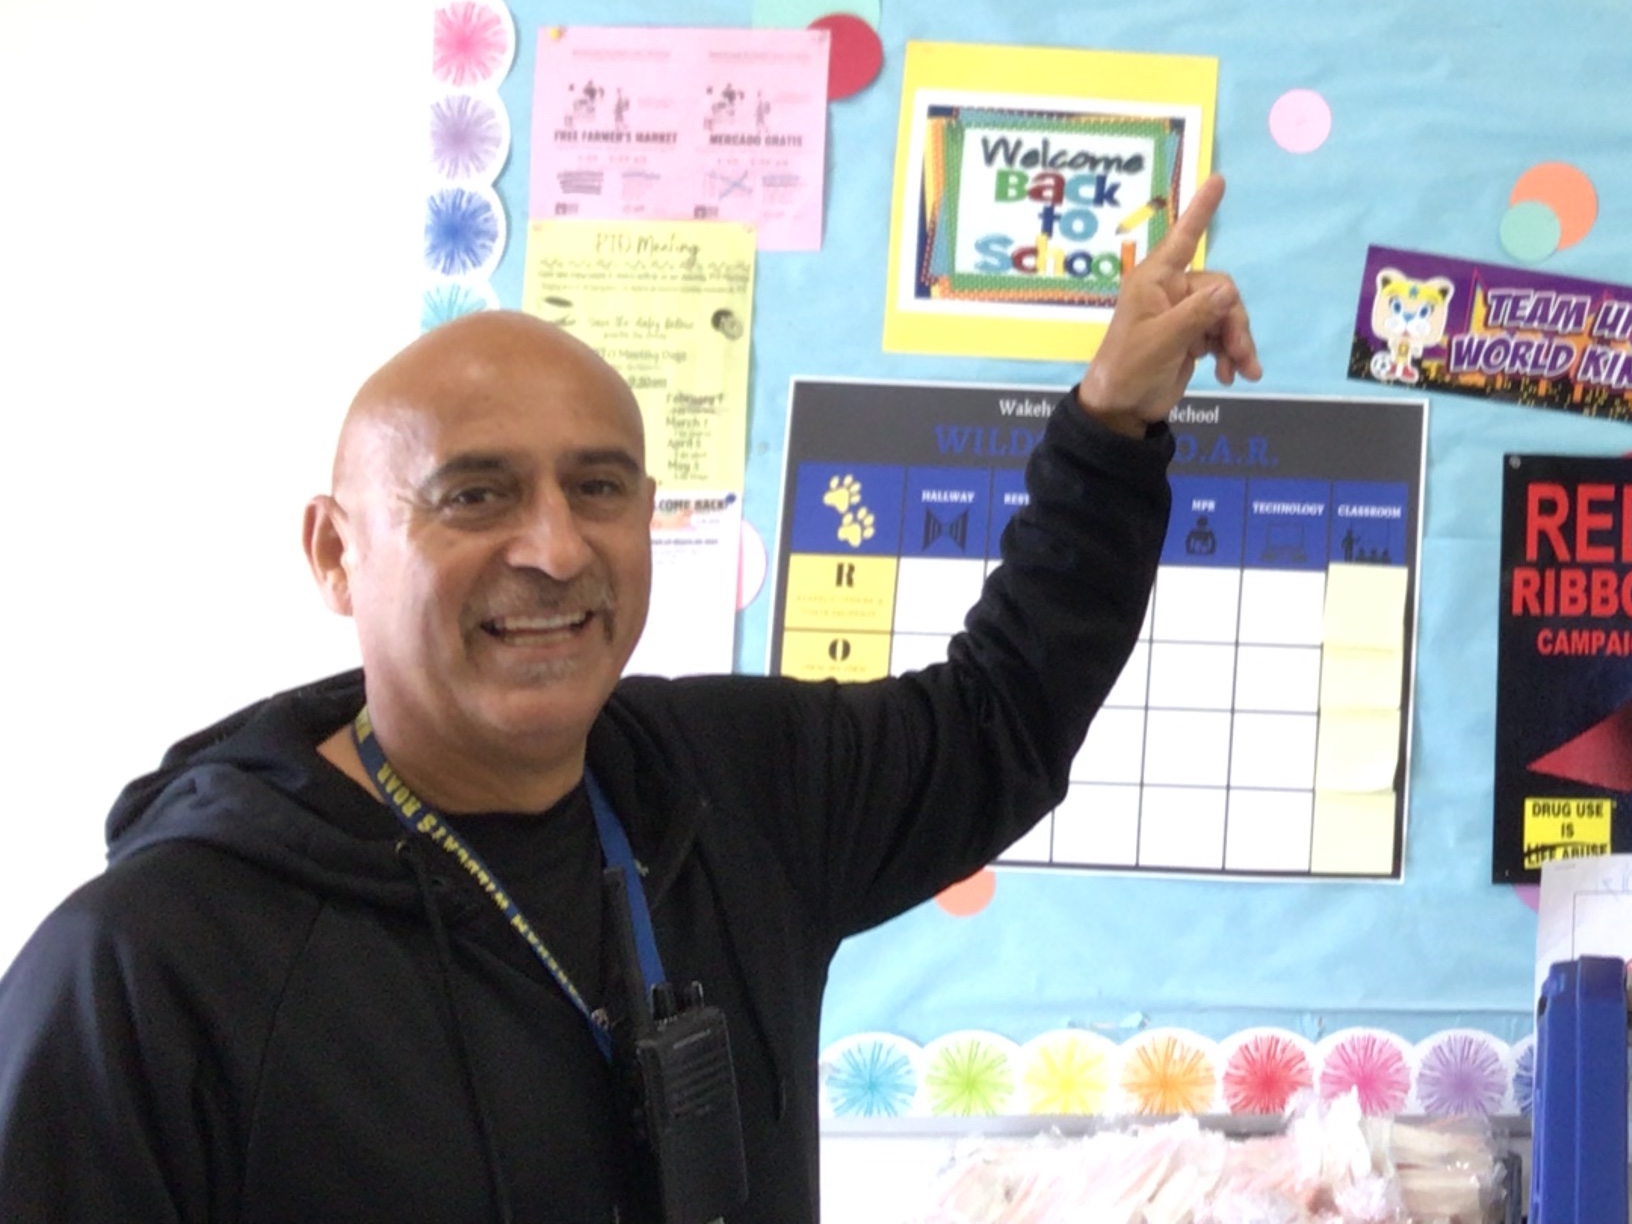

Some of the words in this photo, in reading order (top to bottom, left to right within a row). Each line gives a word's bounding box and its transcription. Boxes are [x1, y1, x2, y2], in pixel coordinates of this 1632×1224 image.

[554, 130, 578, 143] FREE
[581, 130, 631, 144] FARMER'S
[635, 131, 677, 145] MARKET
[709, 133, 761, 146] MERCADO
[981, 134, 1145, 176] Welcome
[1038, 204, 1099, 243] to
[636, 232, 699, 262] Meeting
[973, 232, 1137, 280] School
[1487, 288, 1591, 333] TEAM
[1449, 333, 1576, 377] WORLD
[998, 398, 1055, 418] Wakeh
[935, 424, 1038, 460] WILD
[921, 489, 976, 504] HALLWAY
[1252, 501, 1325, 517] TECHNOLOGY
[1336, 504, 1403, 519] CLASSROOM
[836, 562, 856, 588] R
[828, 638, 851, 662] O
[376, 762, 420, 819] ROAR
[1532, 801, 1572, 818] DRUG
[1576, 802, 1604, 818] USE
[1560, 822, 1575, 839] IS
